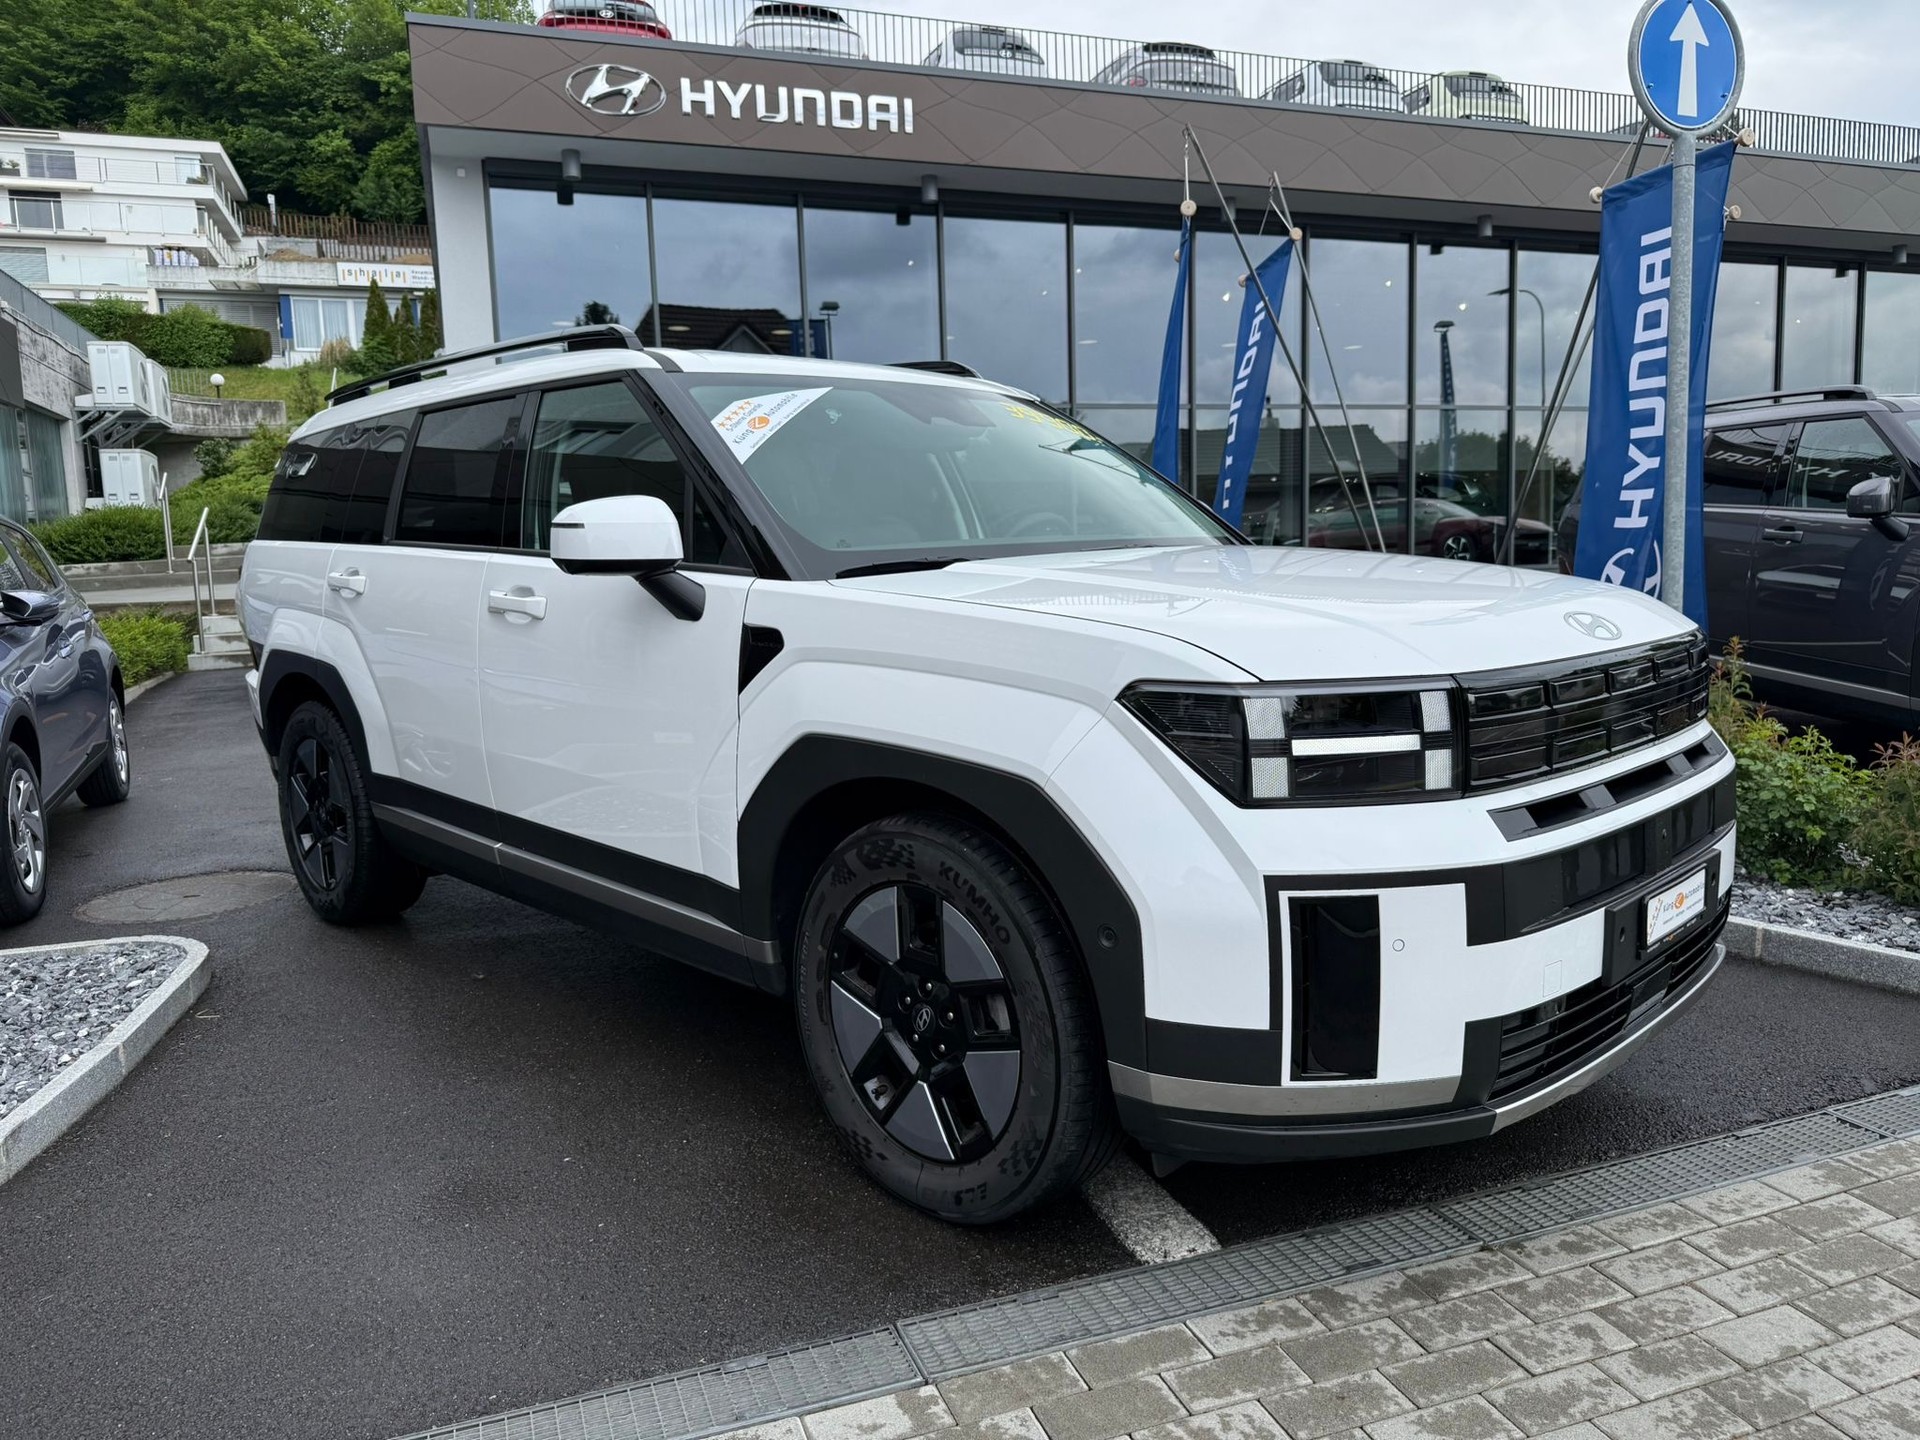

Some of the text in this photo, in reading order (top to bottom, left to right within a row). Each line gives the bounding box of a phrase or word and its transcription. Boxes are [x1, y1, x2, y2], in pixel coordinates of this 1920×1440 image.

[680, 77, 914, 134] HYUNDAI
[1613, 226, 1672, 529] HYUNDAI
[732, 429, 755, 445] Küng
[938, 860, 1010, 945] KUMHO
